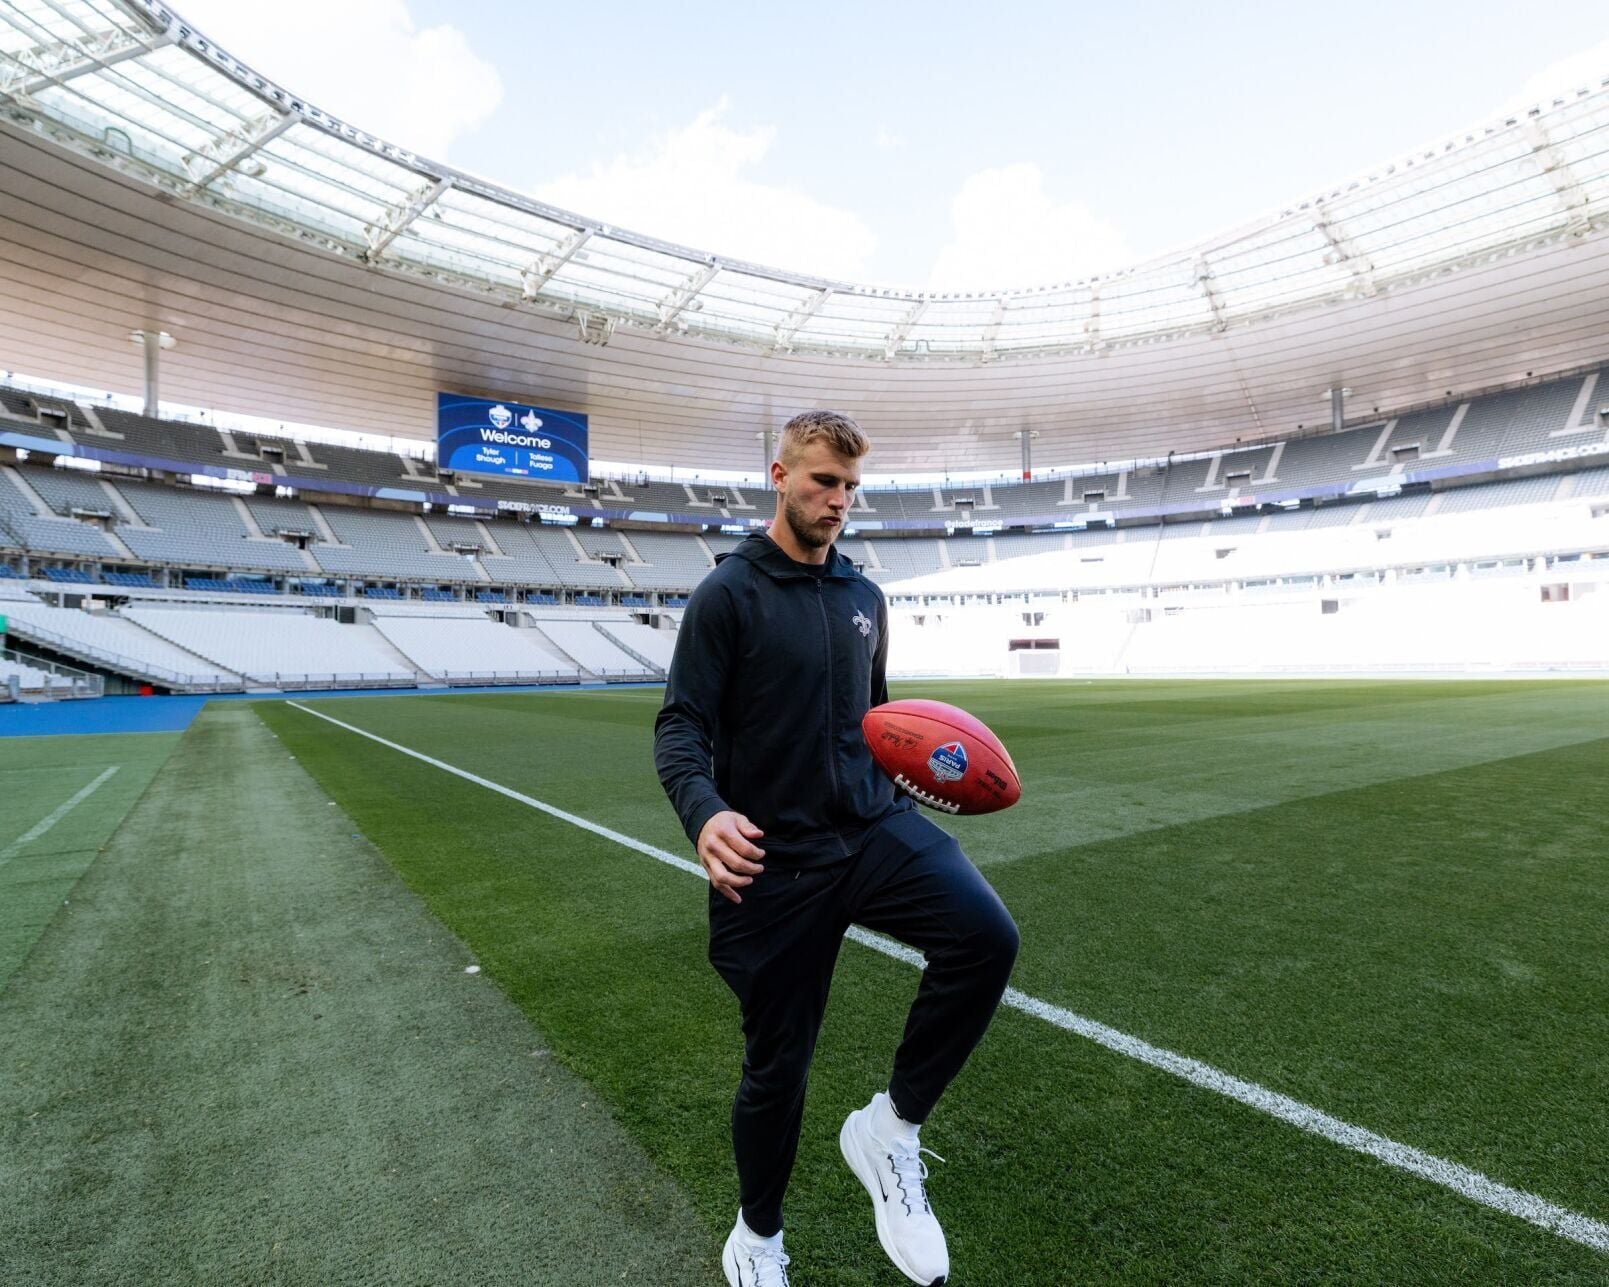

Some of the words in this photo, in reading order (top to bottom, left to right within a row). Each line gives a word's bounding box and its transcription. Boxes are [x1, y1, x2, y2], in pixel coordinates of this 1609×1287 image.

[480, 428, 551, 449] Welcome
[482, 447, 499, 456] Tyler
[476, 454, 506, 464] Shough
[939, 755, 961, 769] PARIS
